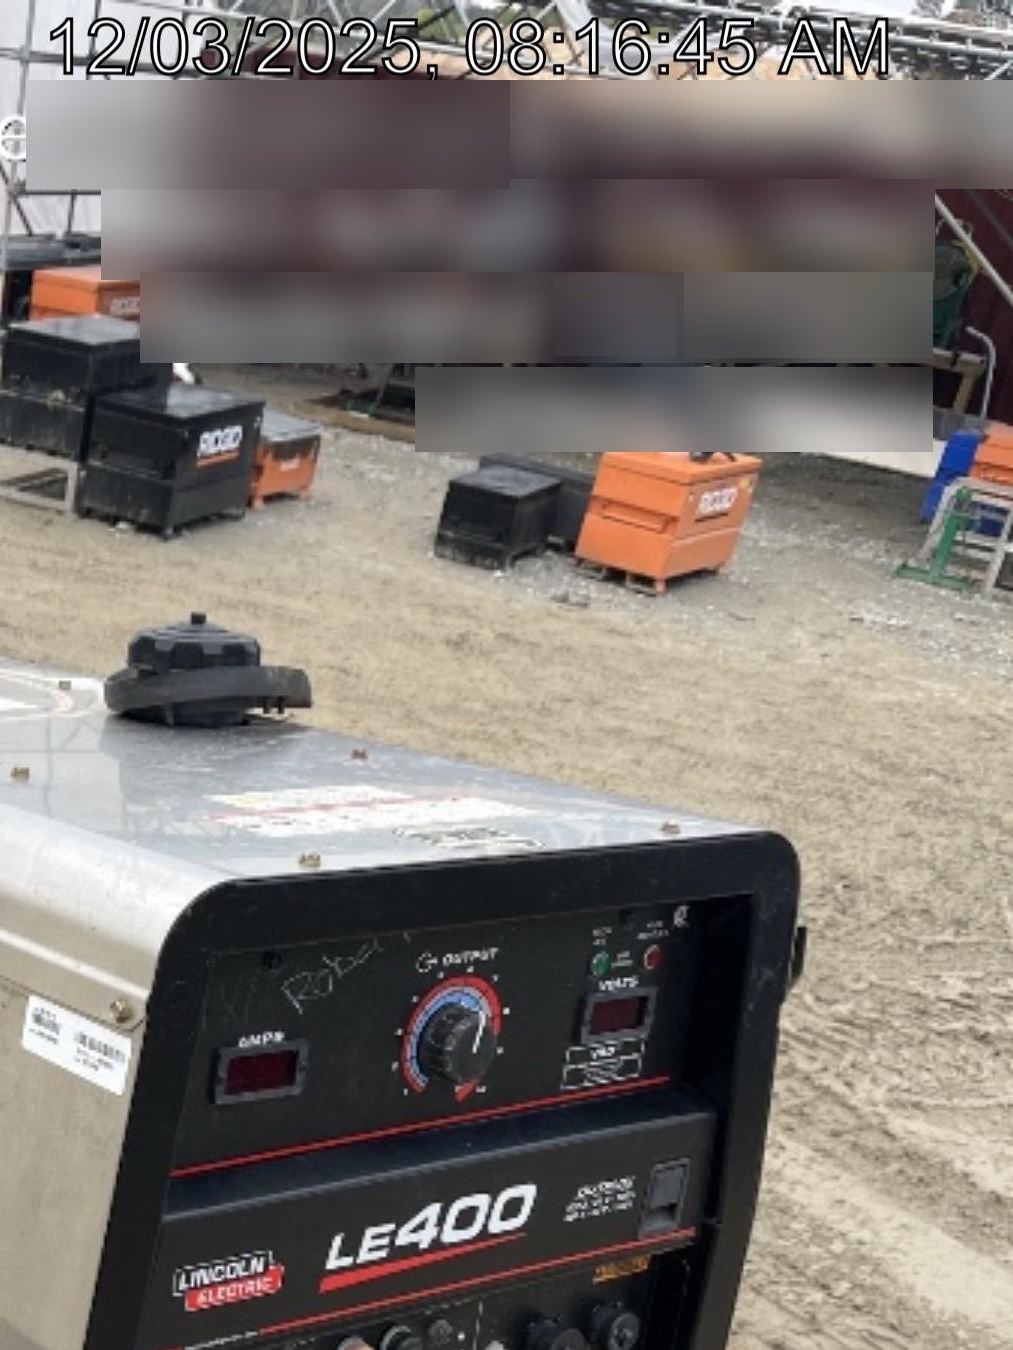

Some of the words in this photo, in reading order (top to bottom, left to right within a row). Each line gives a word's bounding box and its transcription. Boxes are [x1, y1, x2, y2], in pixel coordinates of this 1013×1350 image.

[441, 947, 500, 967] OUTPUT
[238, 1030, 286, 1048] AMPS
[324, 1183, 538, 1271] LE400
[178, 1256, 265, 1291] LINCOLN
[196, 1277, 274, 1304] ELECTRIC
